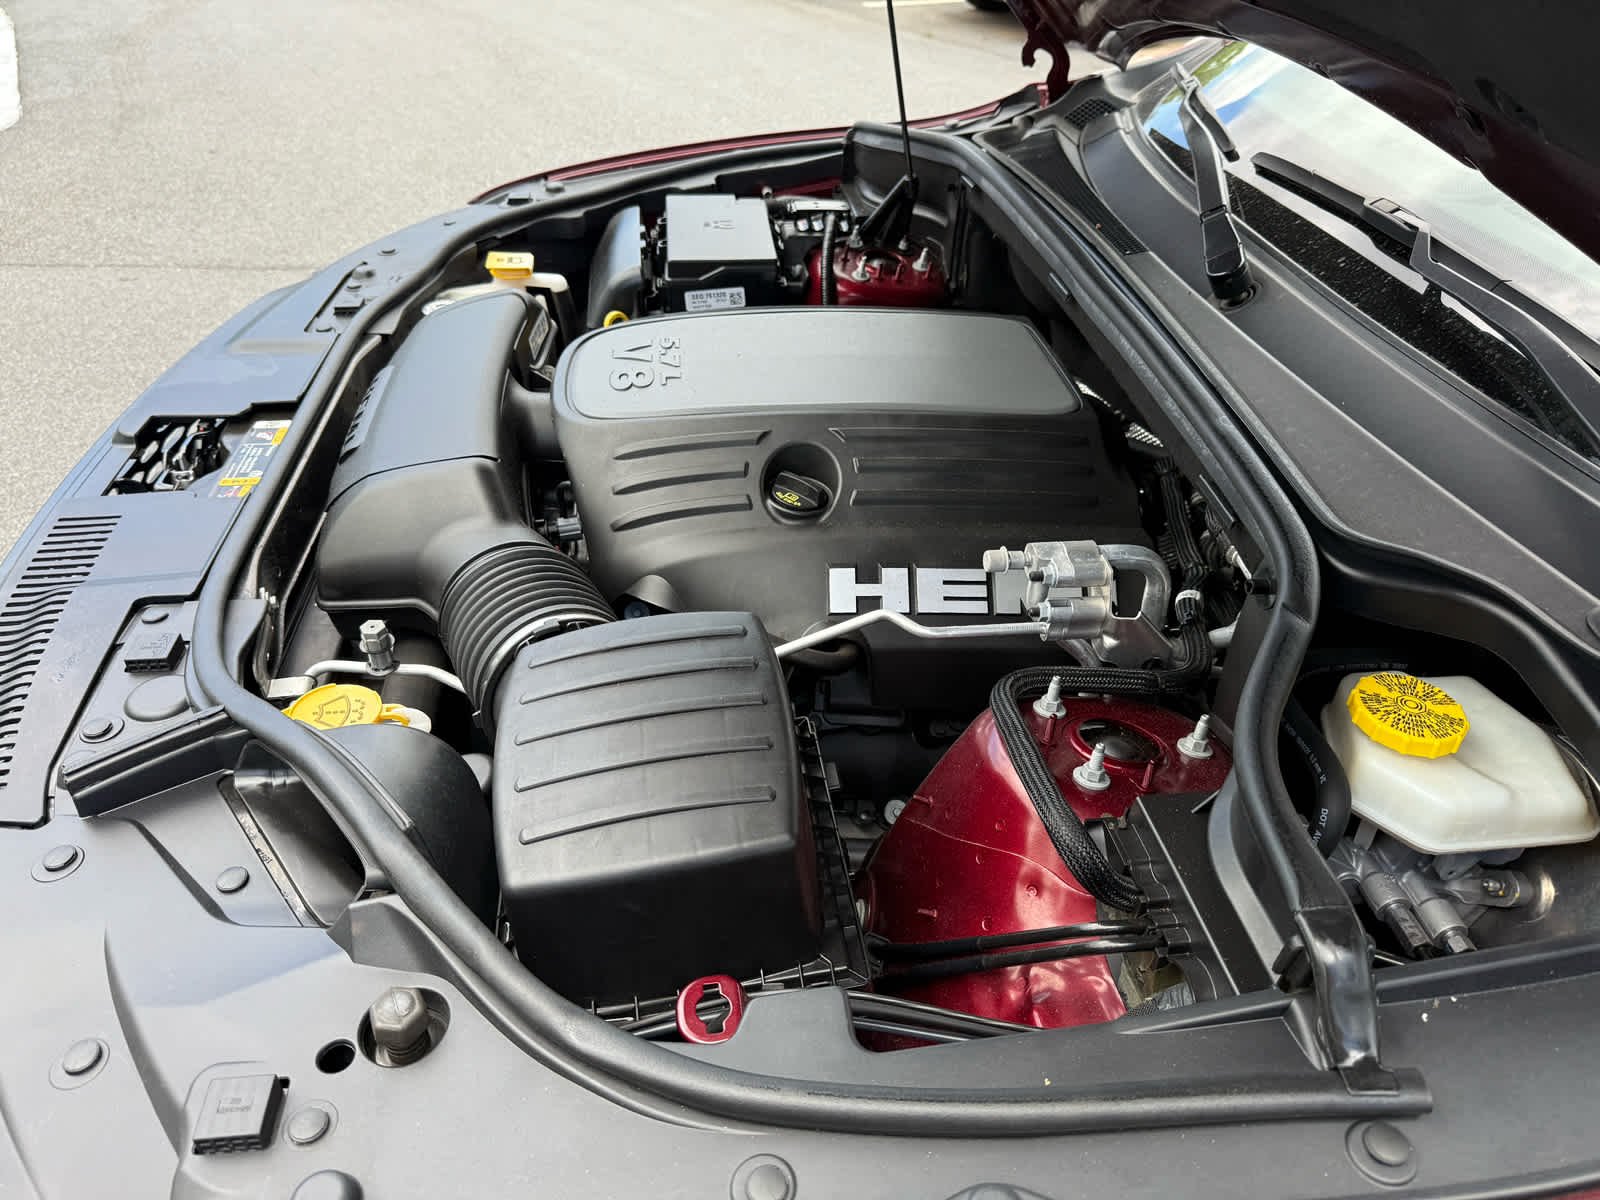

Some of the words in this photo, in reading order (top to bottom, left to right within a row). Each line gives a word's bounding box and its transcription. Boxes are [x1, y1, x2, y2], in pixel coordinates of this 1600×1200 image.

[608, 338, 655, 391] V8
[659, 336, 681, 387] 5.7L
[1318, 807, 1329, 828] DOT
